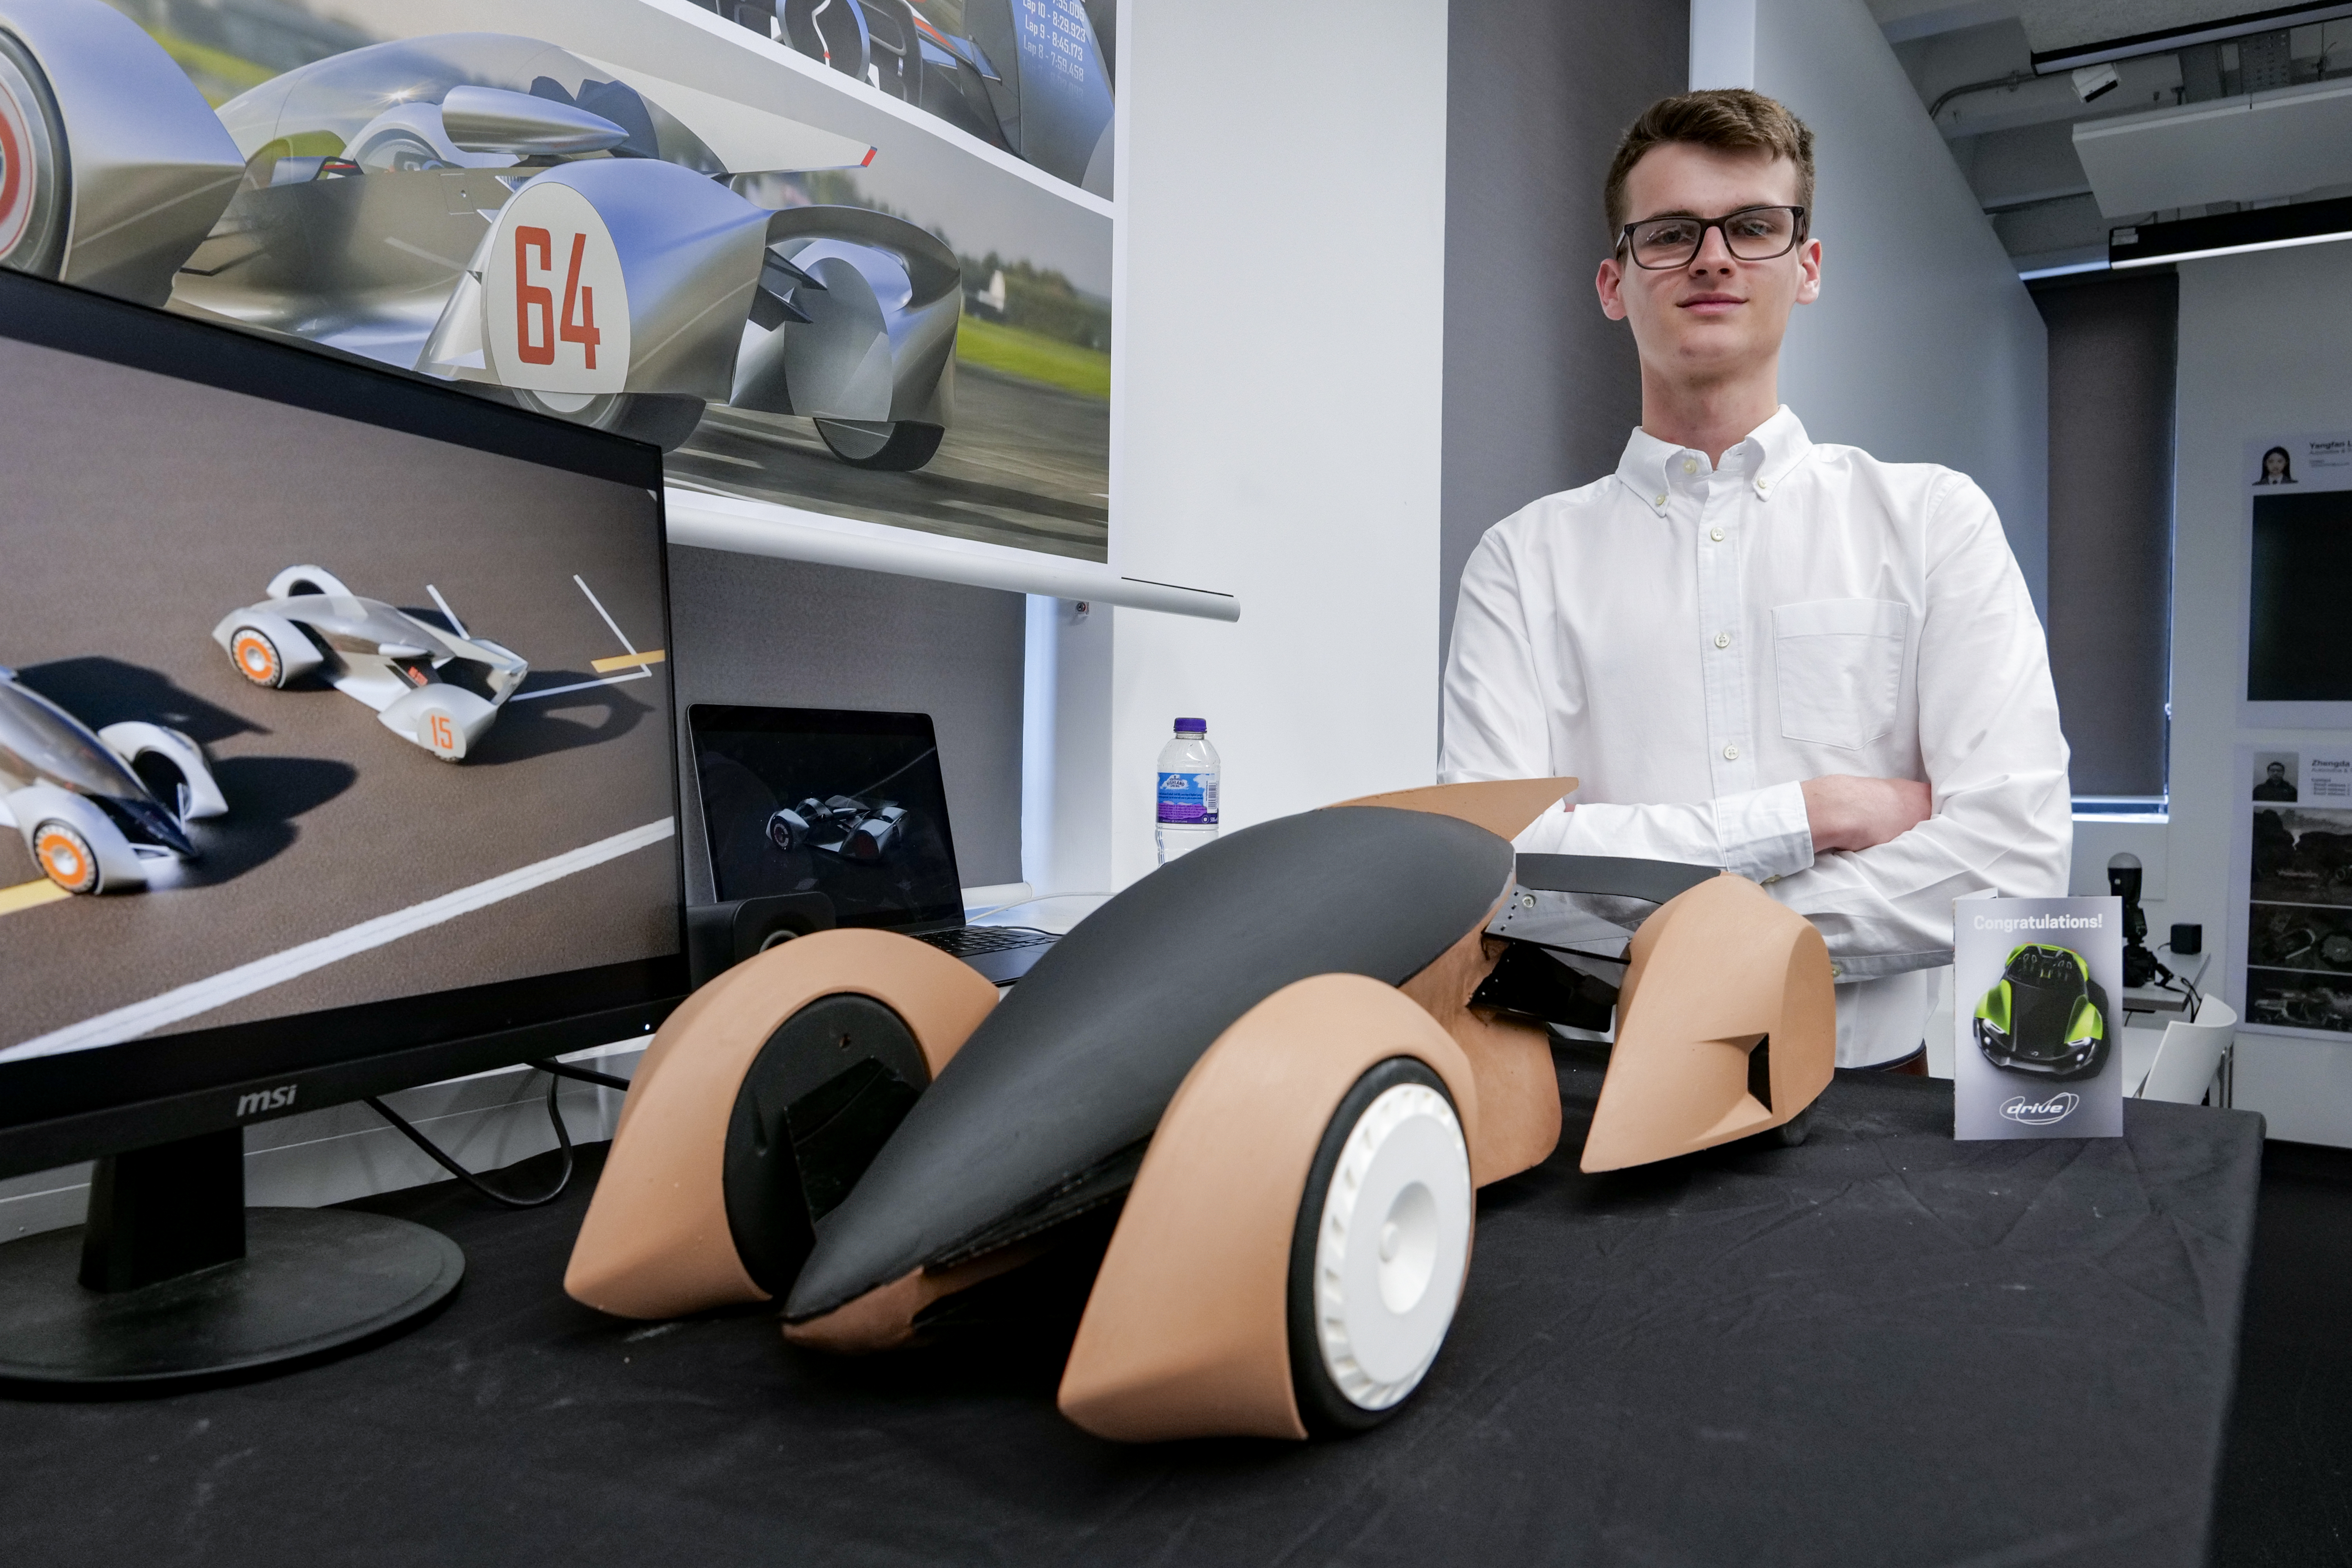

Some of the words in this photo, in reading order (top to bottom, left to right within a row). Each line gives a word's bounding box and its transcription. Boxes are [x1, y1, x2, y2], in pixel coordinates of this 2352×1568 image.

[1025, 14, 1038, 36] Lap
[1040, 24, 1045, 39] 9
[1052, 31, 1083, 61] 8:45.173
[1038, 1, 1045, 18] 10
[1053, 11, 1085, 42] 8:29.923
[1024, 34, 1036, 56] Lap
[1039, 44, 1043, 59] 8
[1051, 51, 1083, 82] 7:59.458
[515, 225, 600, 370] 64
[431, 714, 454, 750] 15
[1974, 913, 2102, 933] Congratulations!
[236, 1084, 298, 1117] msi
[2006, 1103, 2063, 1114] drive
